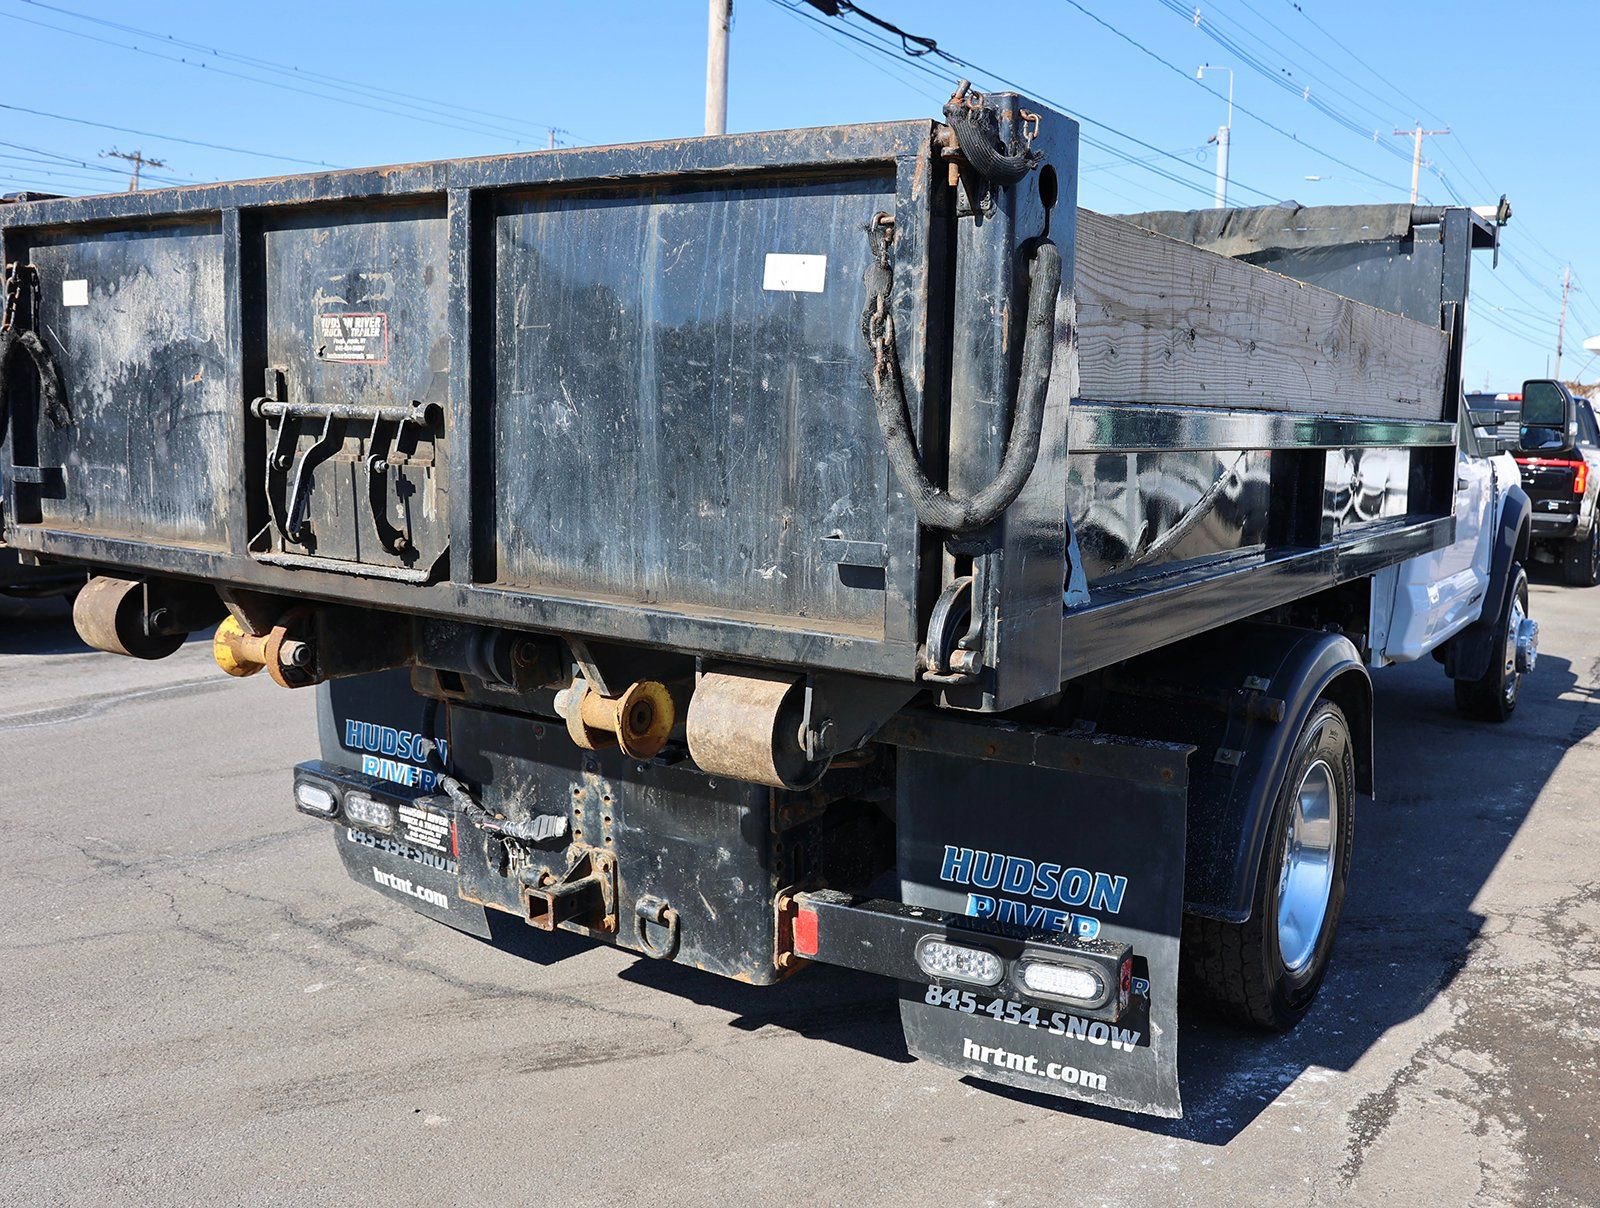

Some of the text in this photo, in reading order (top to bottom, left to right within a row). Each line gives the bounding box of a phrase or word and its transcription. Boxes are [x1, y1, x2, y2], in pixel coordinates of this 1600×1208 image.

[320, 317, 381, 328] UDSN RIVER
[345, 719, 448, 766] HUDSON
[362, 754, 437, 793] RIVER
[372, 866, 449, 909] hrtnt.com
[940, 845, 1128, 914] HUDSON
[965, 892, 1101, 942] RIVER
[924, 984, 1141, 1053] 845-454-SNOW
[962, 1037, 1107, 1091] hrtnt.com
